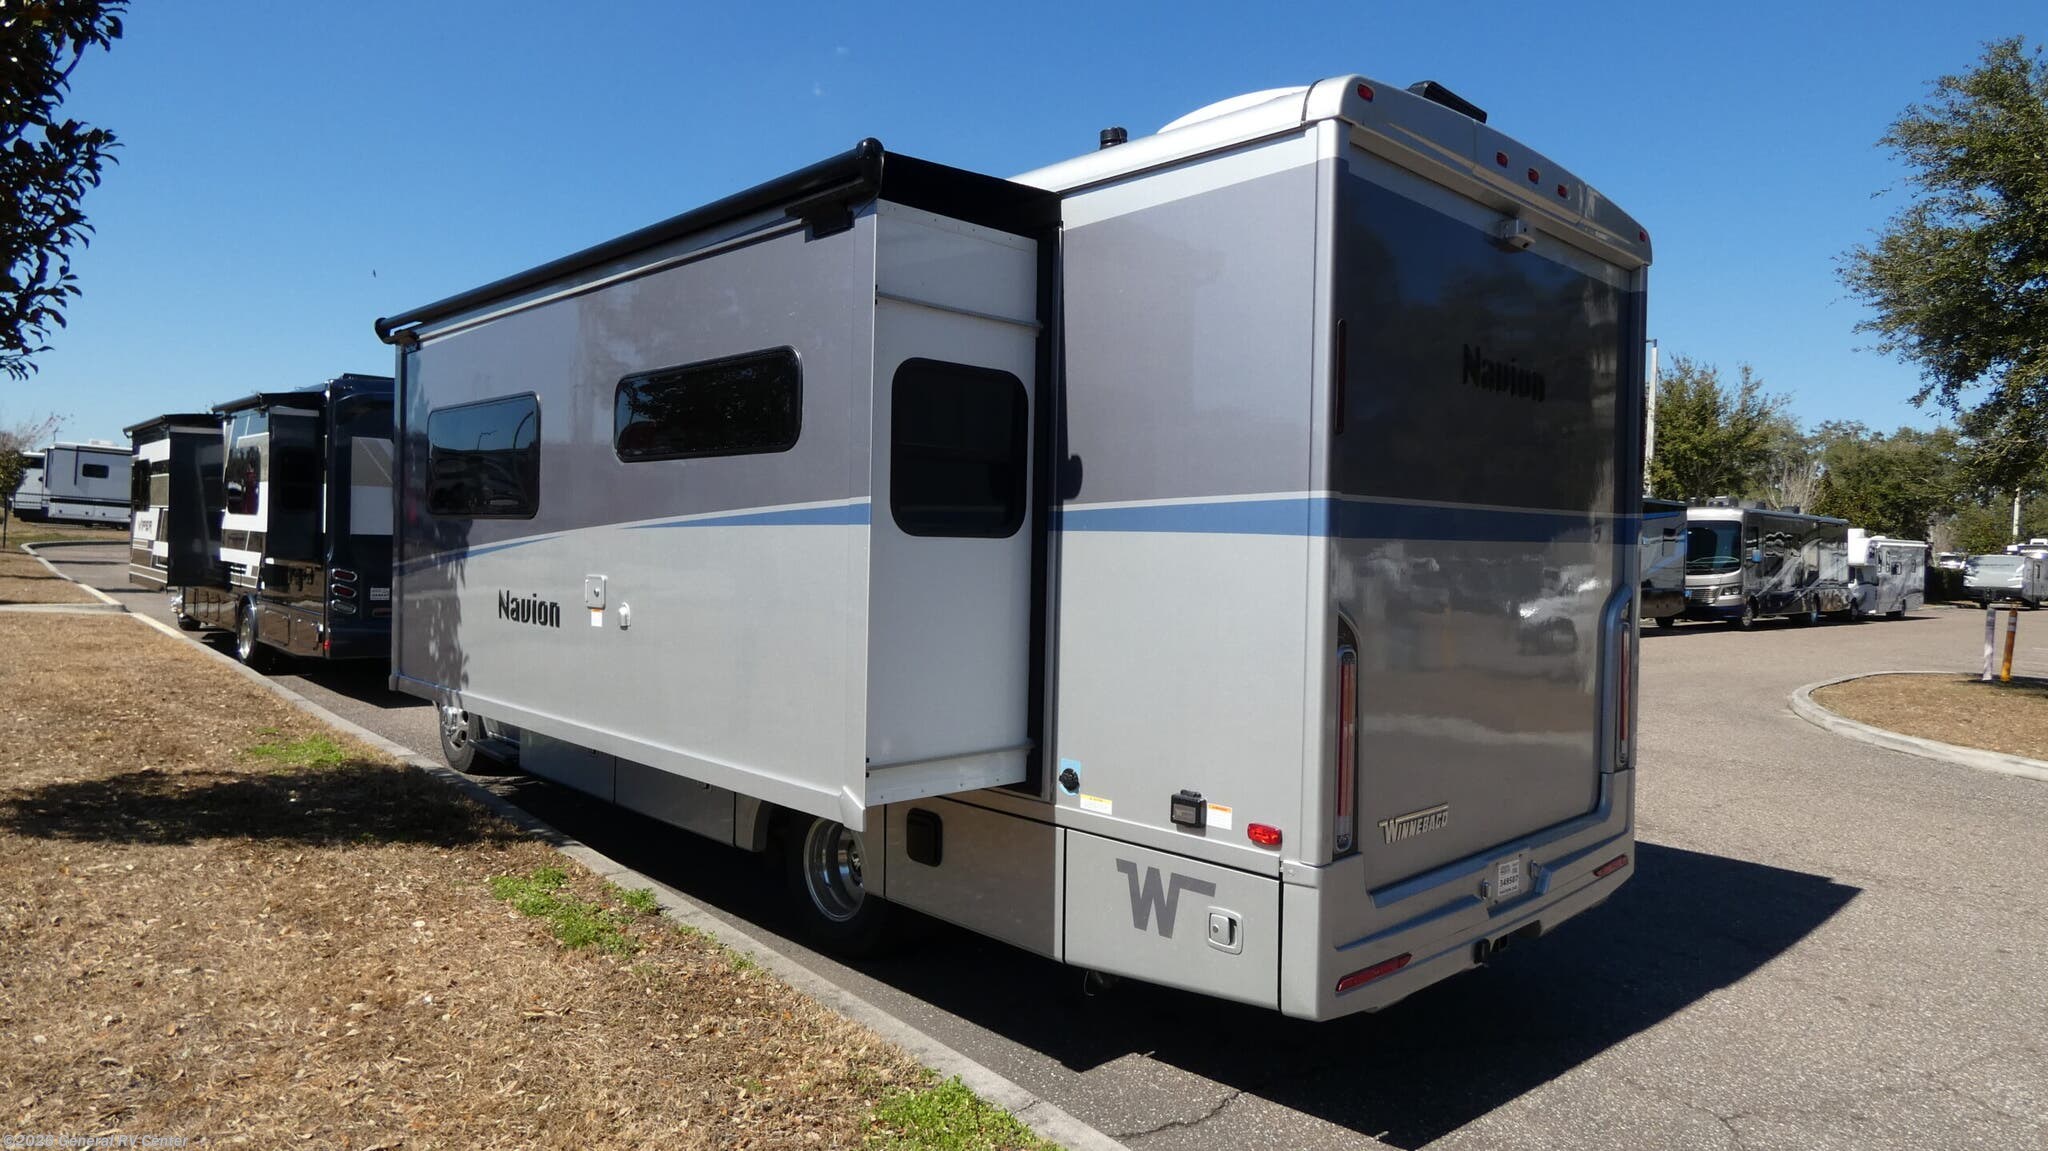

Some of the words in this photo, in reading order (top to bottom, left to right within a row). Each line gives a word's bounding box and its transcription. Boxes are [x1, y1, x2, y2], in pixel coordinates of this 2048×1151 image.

[1462, 343, 1546, 403] Navion
[498, 588, 561, 629] Navion
[1377, 802, 1449, 845] WINNEBAGO
